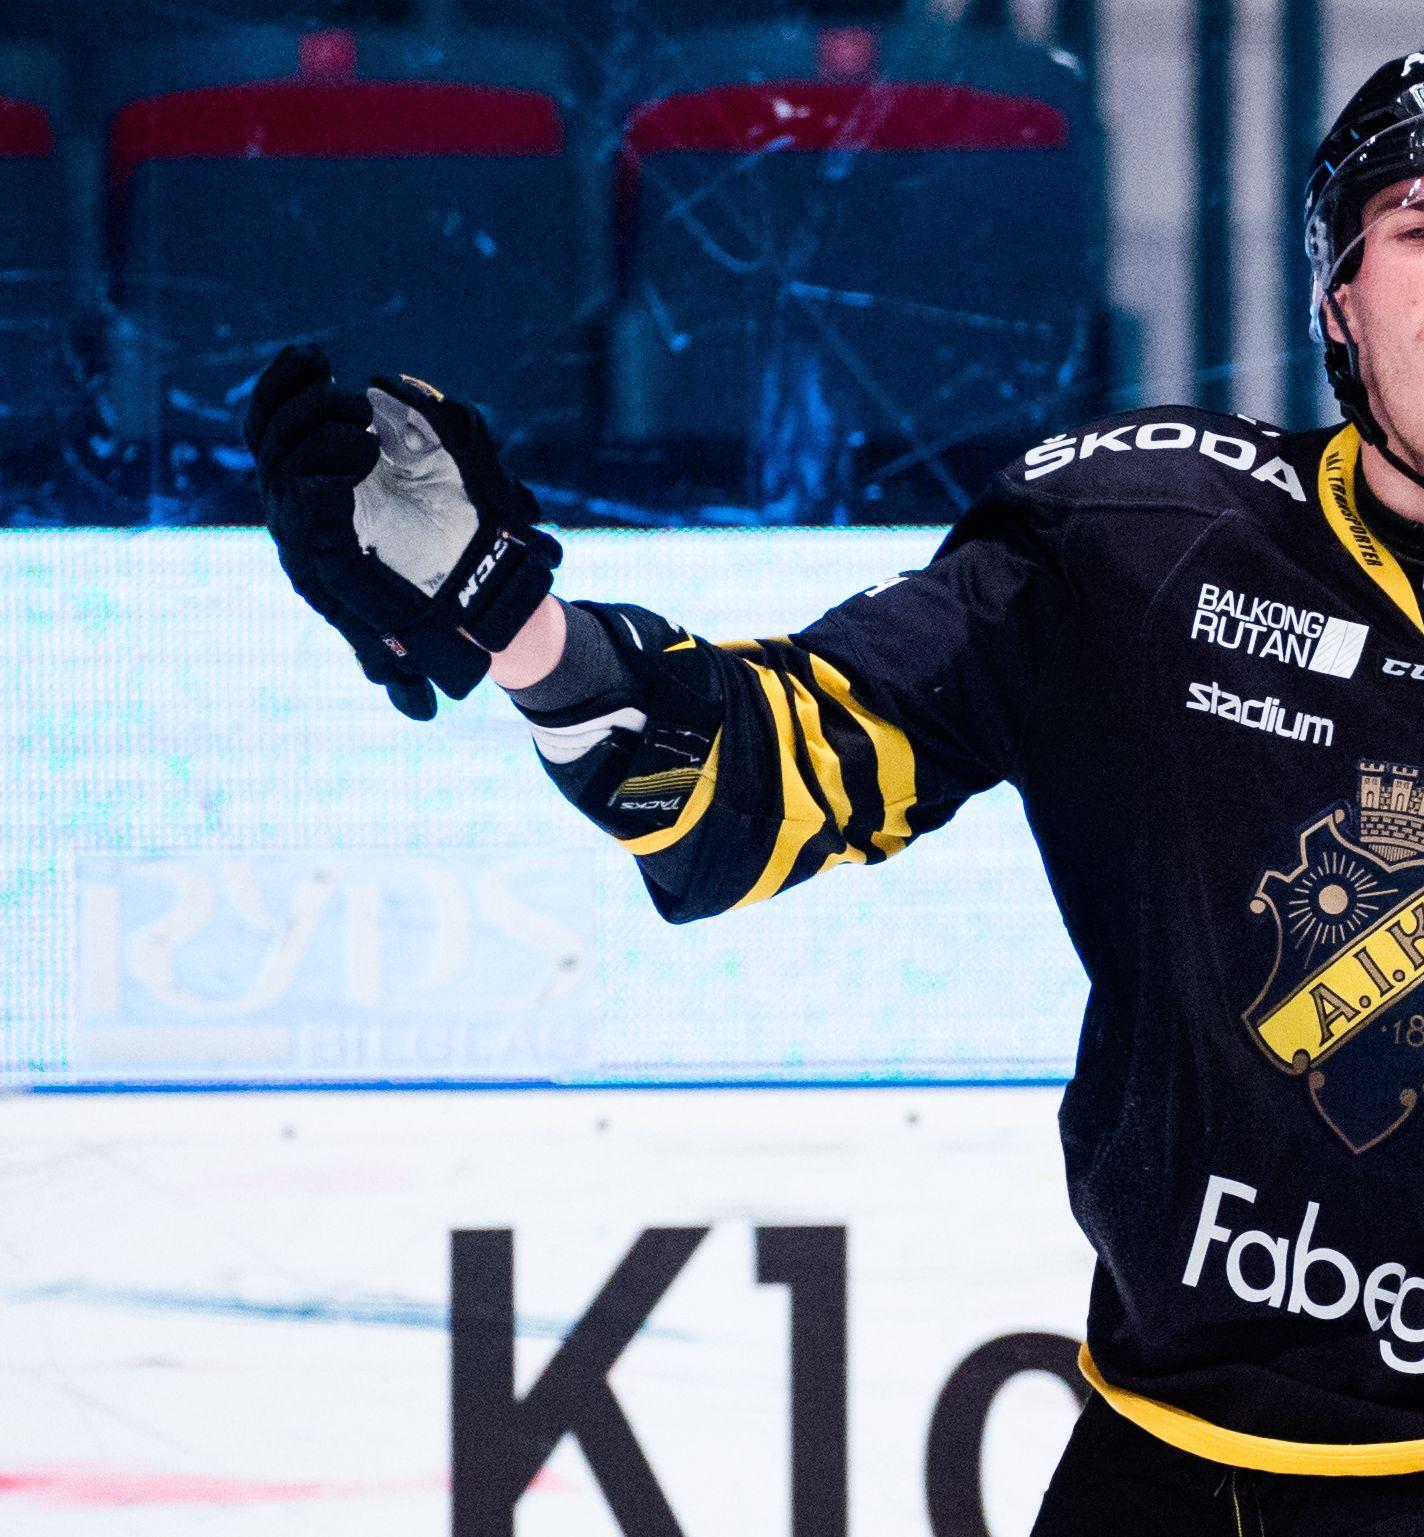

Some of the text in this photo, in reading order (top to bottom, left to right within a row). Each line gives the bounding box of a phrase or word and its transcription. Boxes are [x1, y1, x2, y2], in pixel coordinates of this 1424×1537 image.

[1025, 422, 1307, 503] ŠKODA
[1191, 609, 1312, 668] RUTAN
[1197, 583, 1325, 639] BALKONG
[1186, 682, 1333, 746] stadium
[620, 796, 681, 810] TACKS
